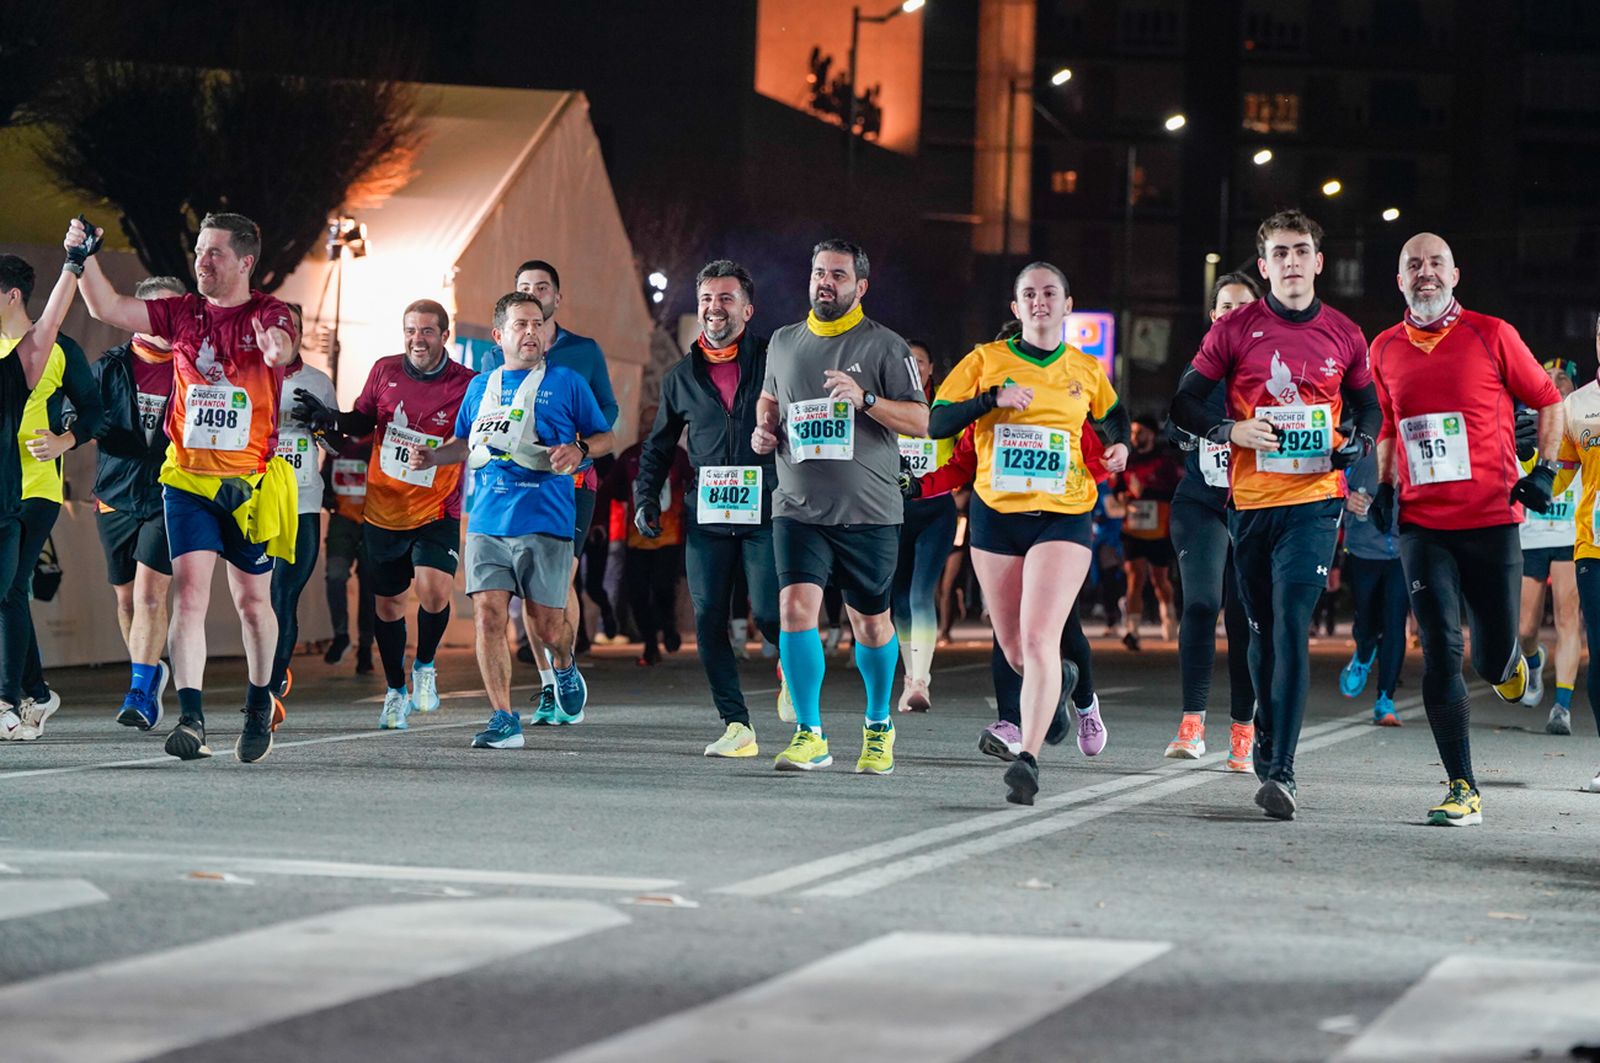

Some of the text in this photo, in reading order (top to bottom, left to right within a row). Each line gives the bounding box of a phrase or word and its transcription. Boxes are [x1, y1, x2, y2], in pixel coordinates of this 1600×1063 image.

[1012, 432, 1033, 440] NOCHE
[1003, 439, 1016, 447] SAN
[1002, 448, 1060, 471] 12328
[709, 486, 750, 504] 8402
